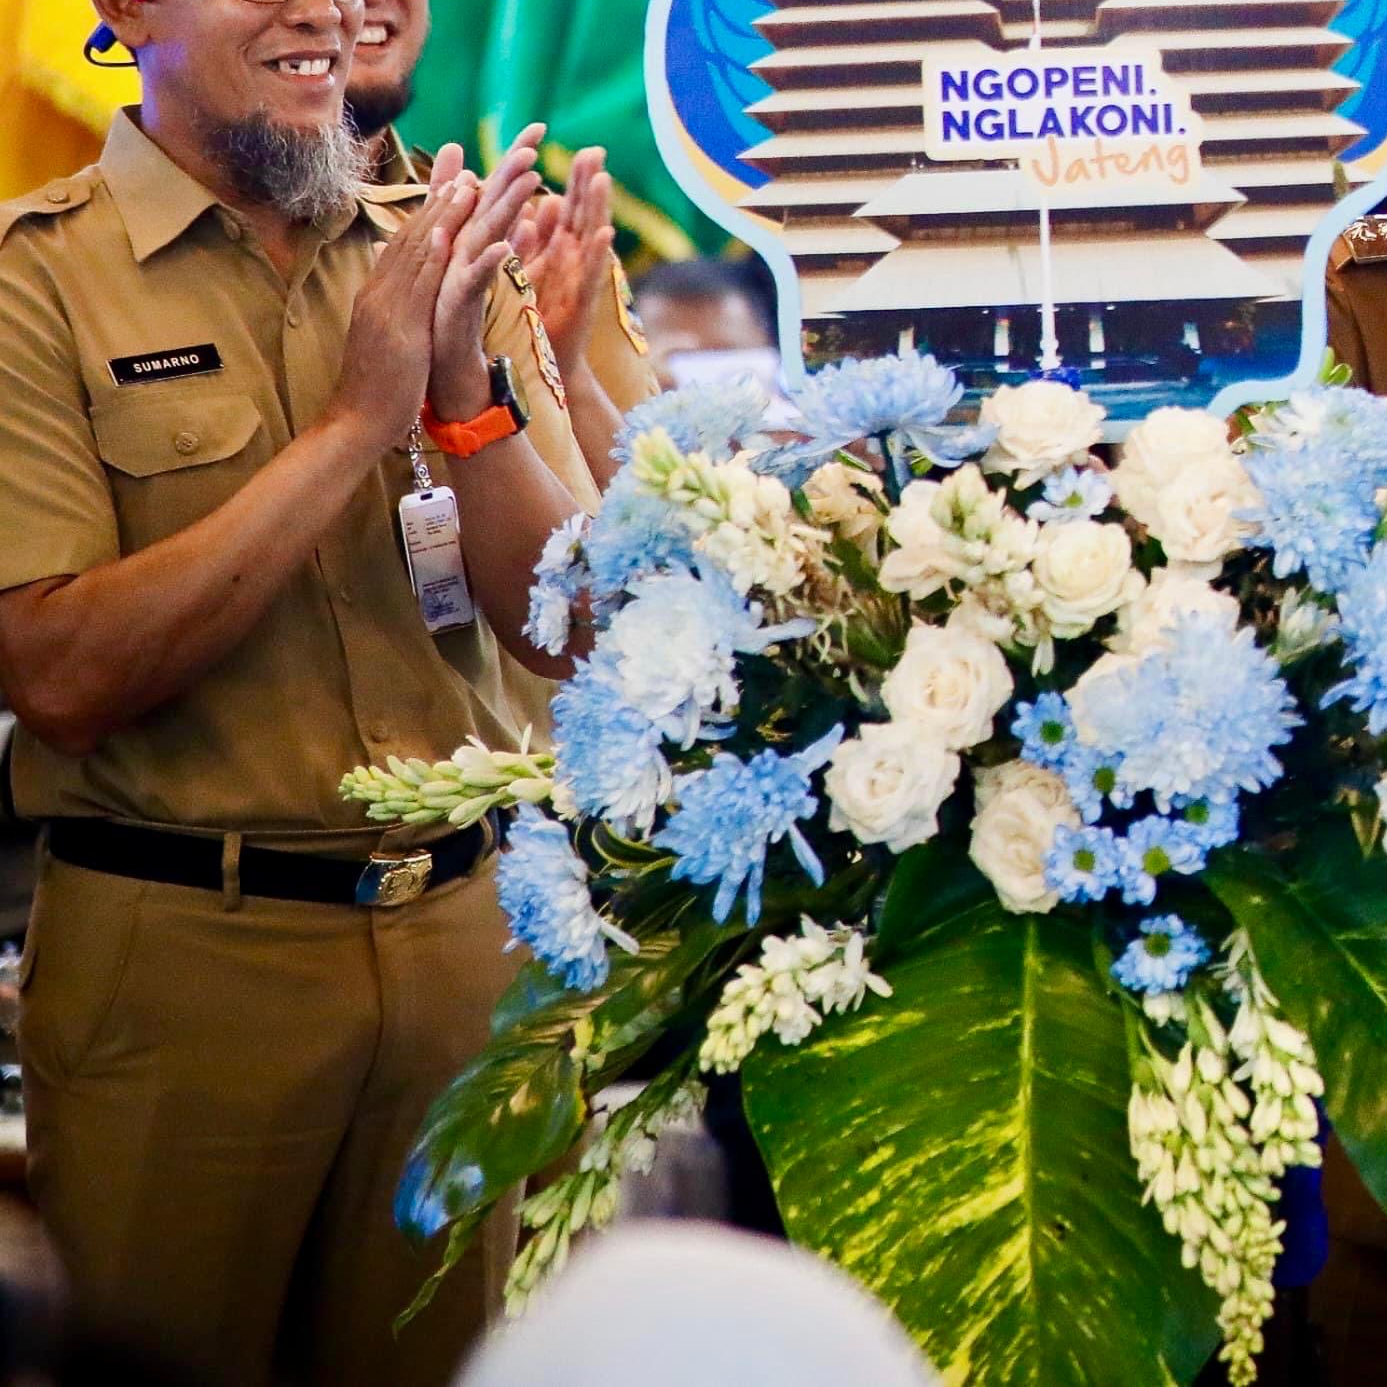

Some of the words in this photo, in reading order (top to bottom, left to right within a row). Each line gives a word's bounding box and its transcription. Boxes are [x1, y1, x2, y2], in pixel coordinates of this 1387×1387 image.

[941, 64, 1157, 102] NGOPENI.
[942, 102, 1187, 142] NGLAKONI.
[1031, 136, 1190, 187] Jateng
[132, 354, 200, 374] SUMARNO
